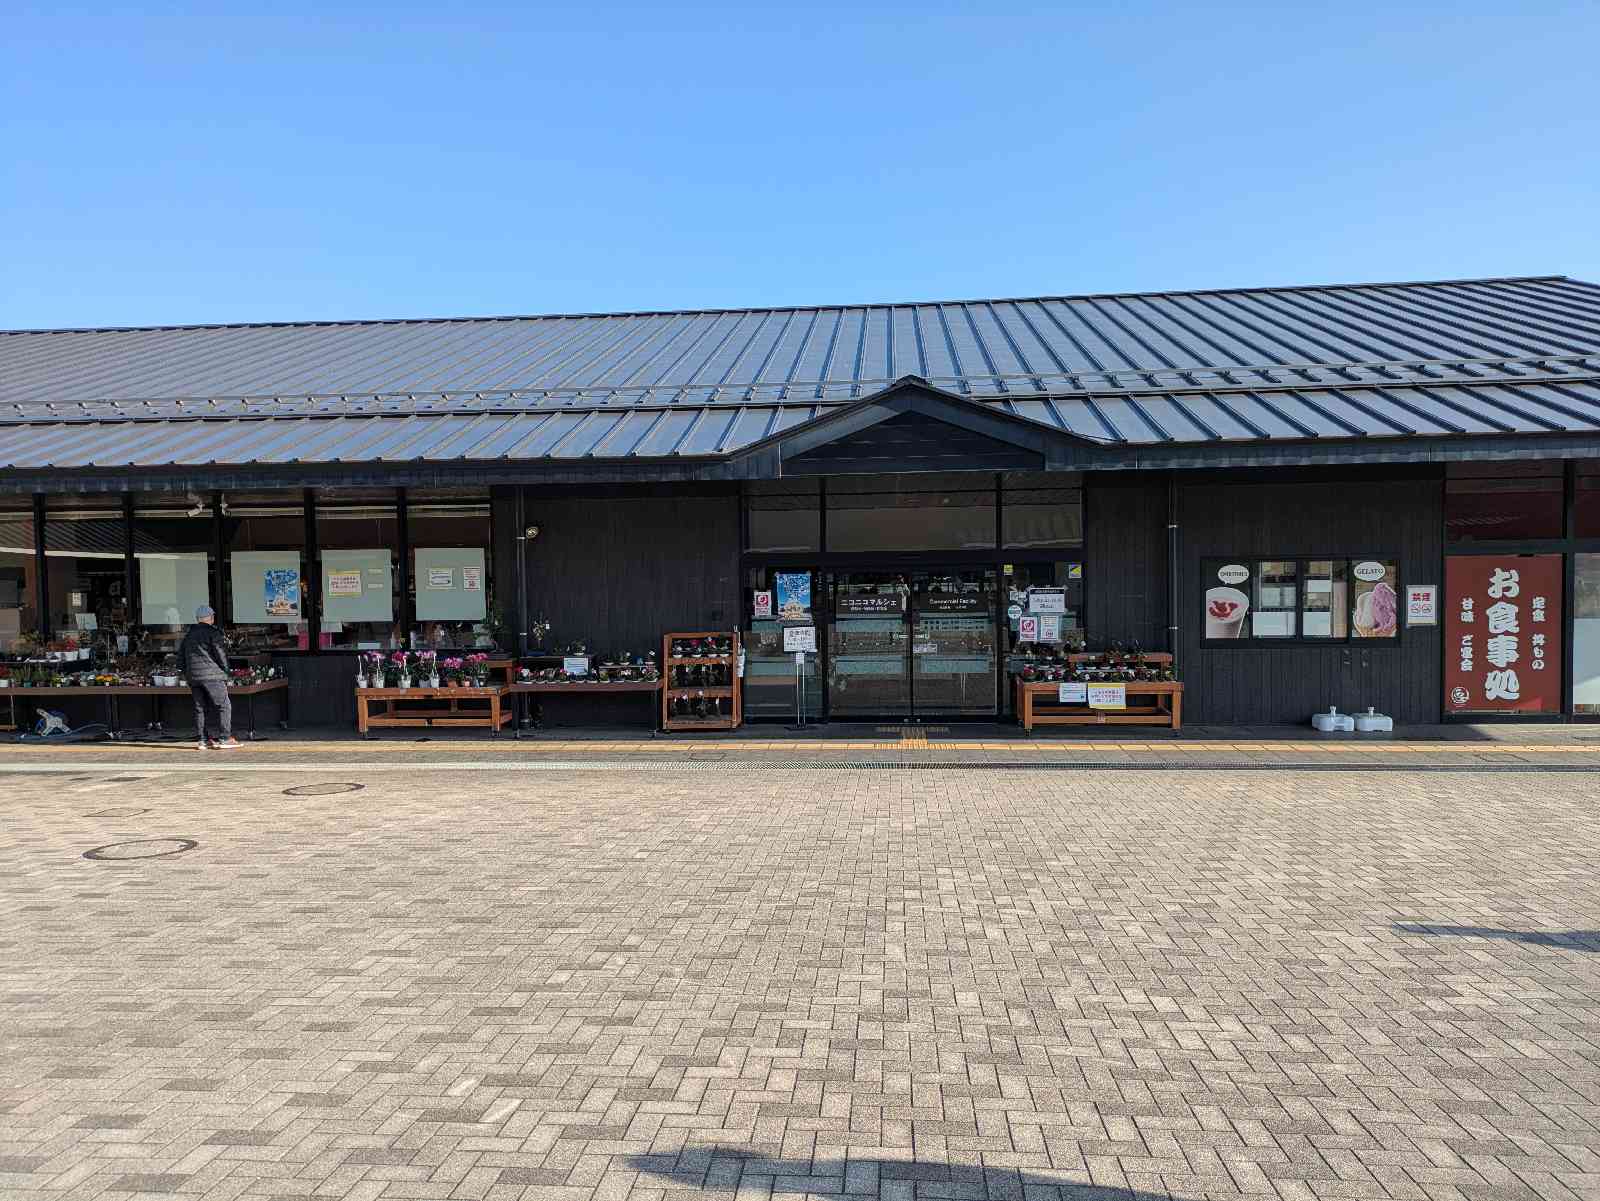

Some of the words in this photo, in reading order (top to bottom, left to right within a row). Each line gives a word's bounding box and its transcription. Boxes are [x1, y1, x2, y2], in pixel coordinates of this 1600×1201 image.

[1356, 567, 1384, 575] GELATO
[1532, 596, 1546, 622] 定食
[1485, 567, 1520, 700] お食事処
